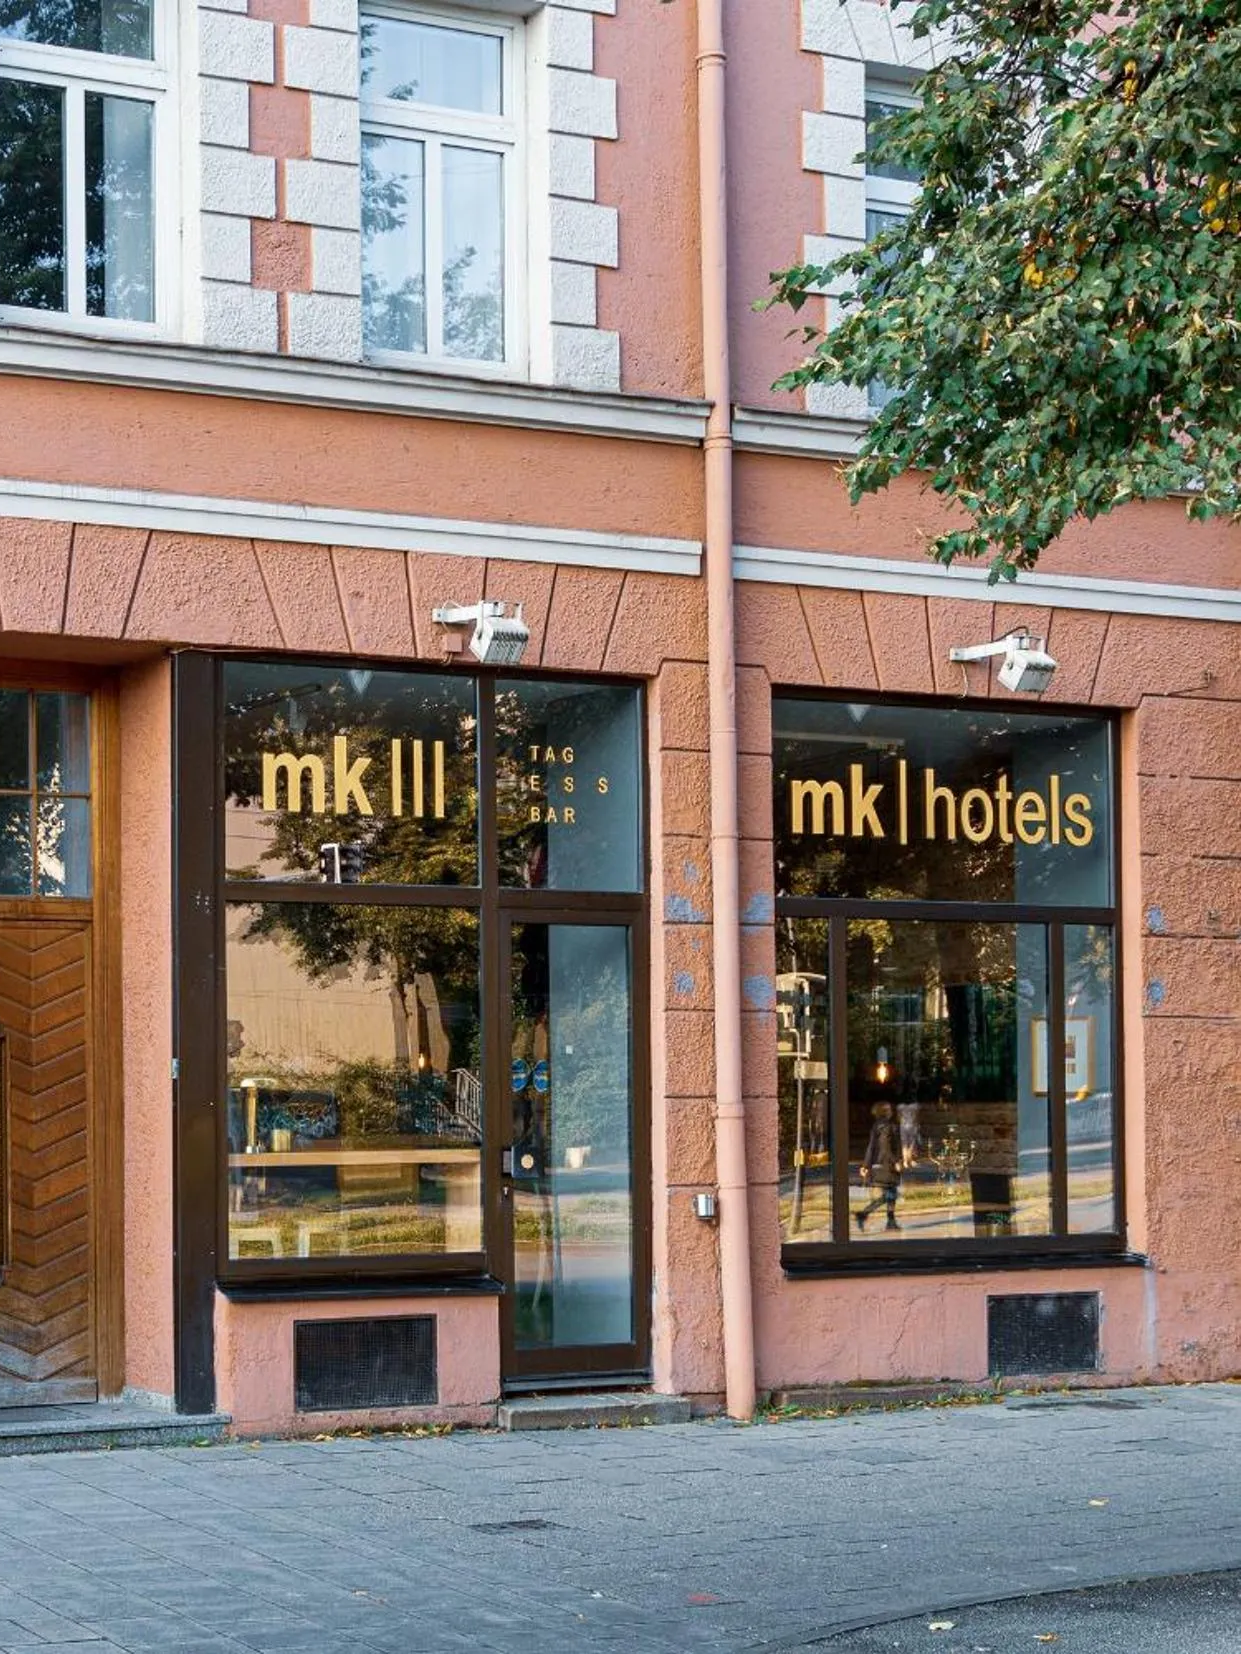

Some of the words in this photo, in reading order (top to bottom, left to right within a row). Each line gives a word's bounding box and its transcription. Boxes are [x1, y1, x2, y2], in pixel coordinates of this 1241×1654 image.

[262, 735, 374, 817] mk
[529, 745, 575, 764] TAG
[529, 807, 576, 825] BAR
[790, 763, 885, 838] mk
[925, 767, 1094, 847] hotels
